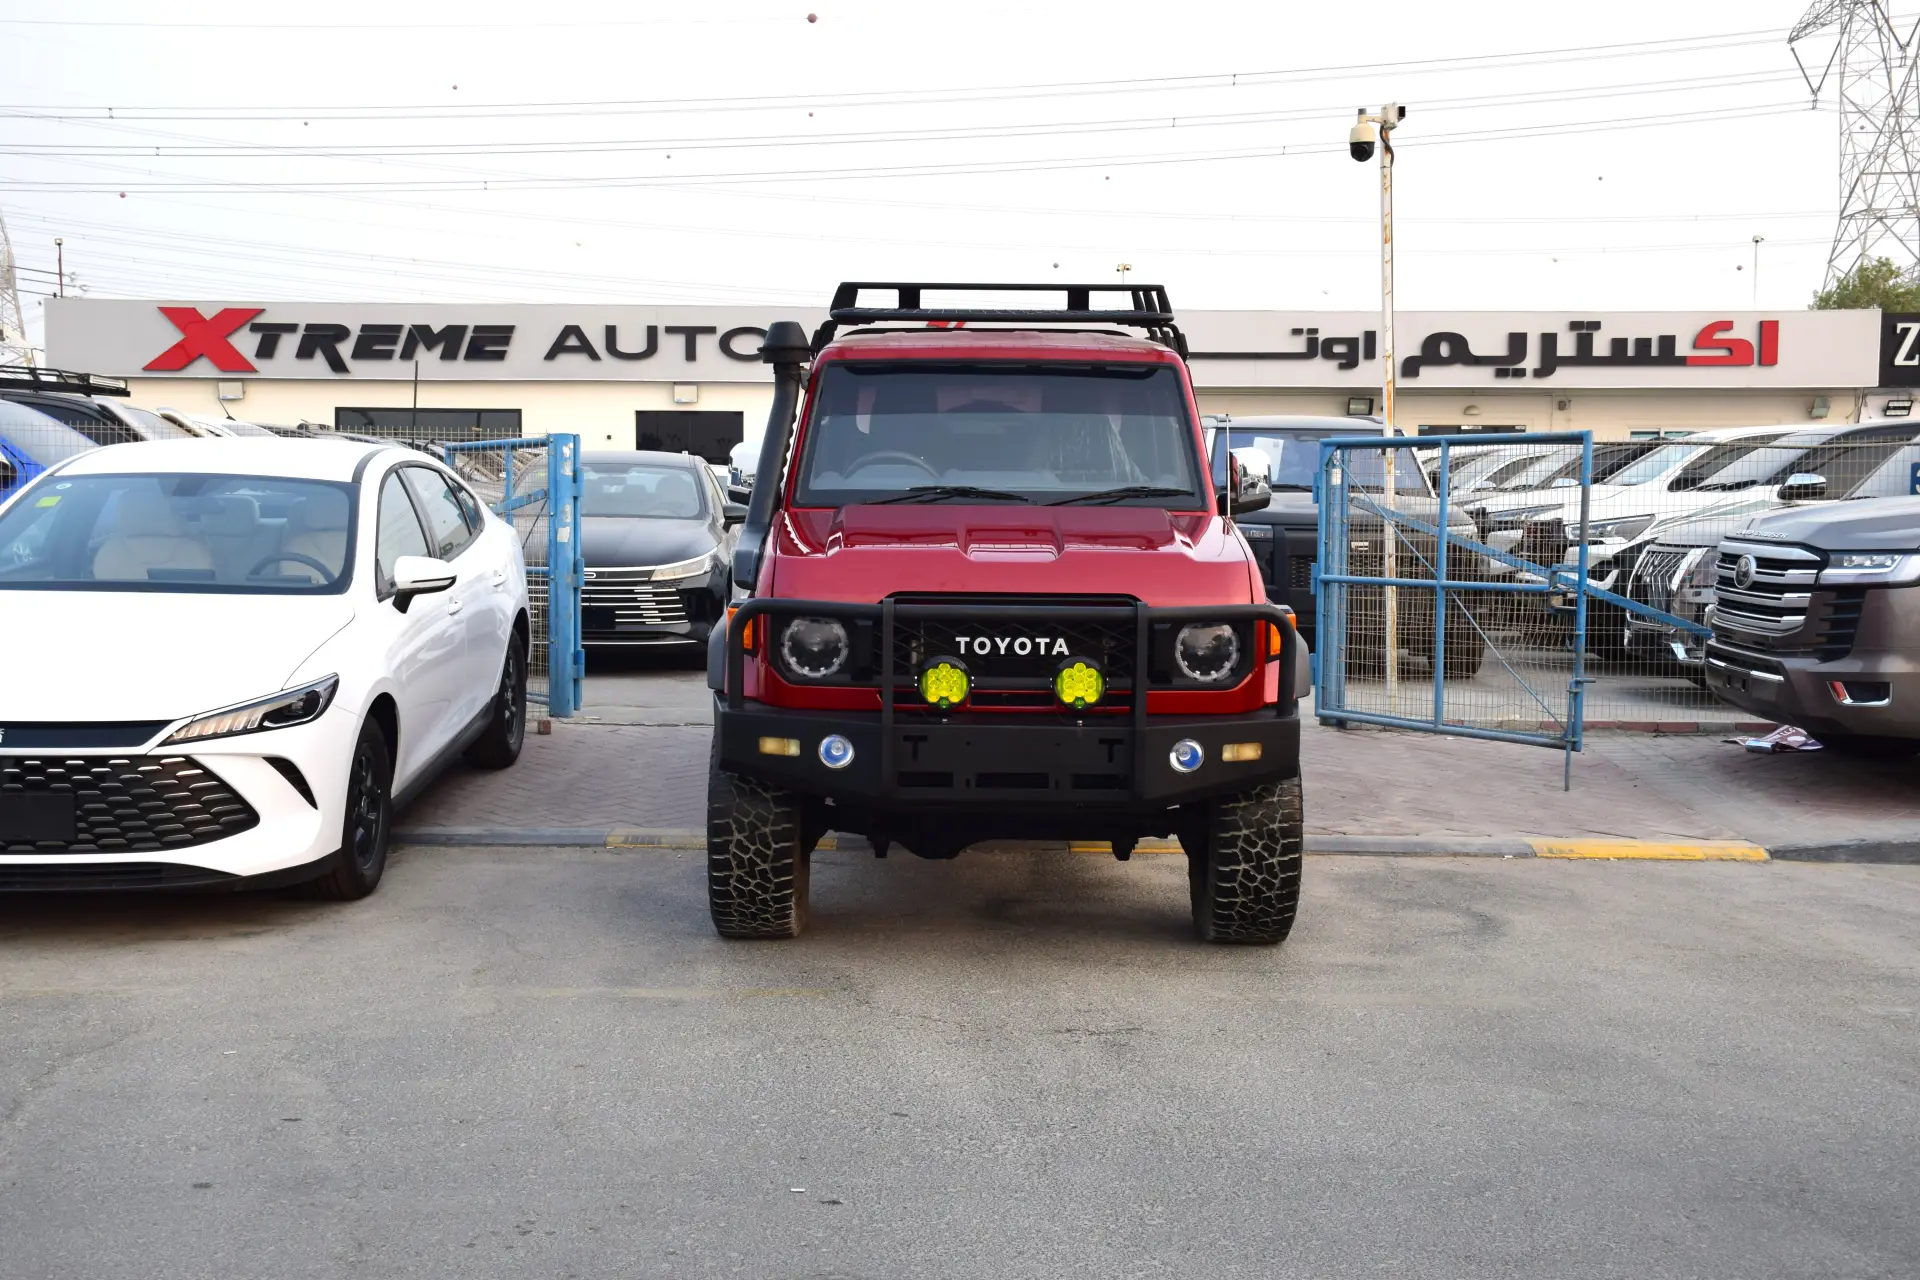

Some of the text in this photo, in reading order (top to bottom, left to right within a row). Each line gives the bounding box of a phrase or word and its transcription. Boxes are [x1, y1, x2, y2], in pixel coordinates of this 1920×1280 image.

[142, 306, 516, 373] XTREME
[1401, 320, 1779, 378] اكستريم
[955, 637, 1070, 656] TOYOTA
